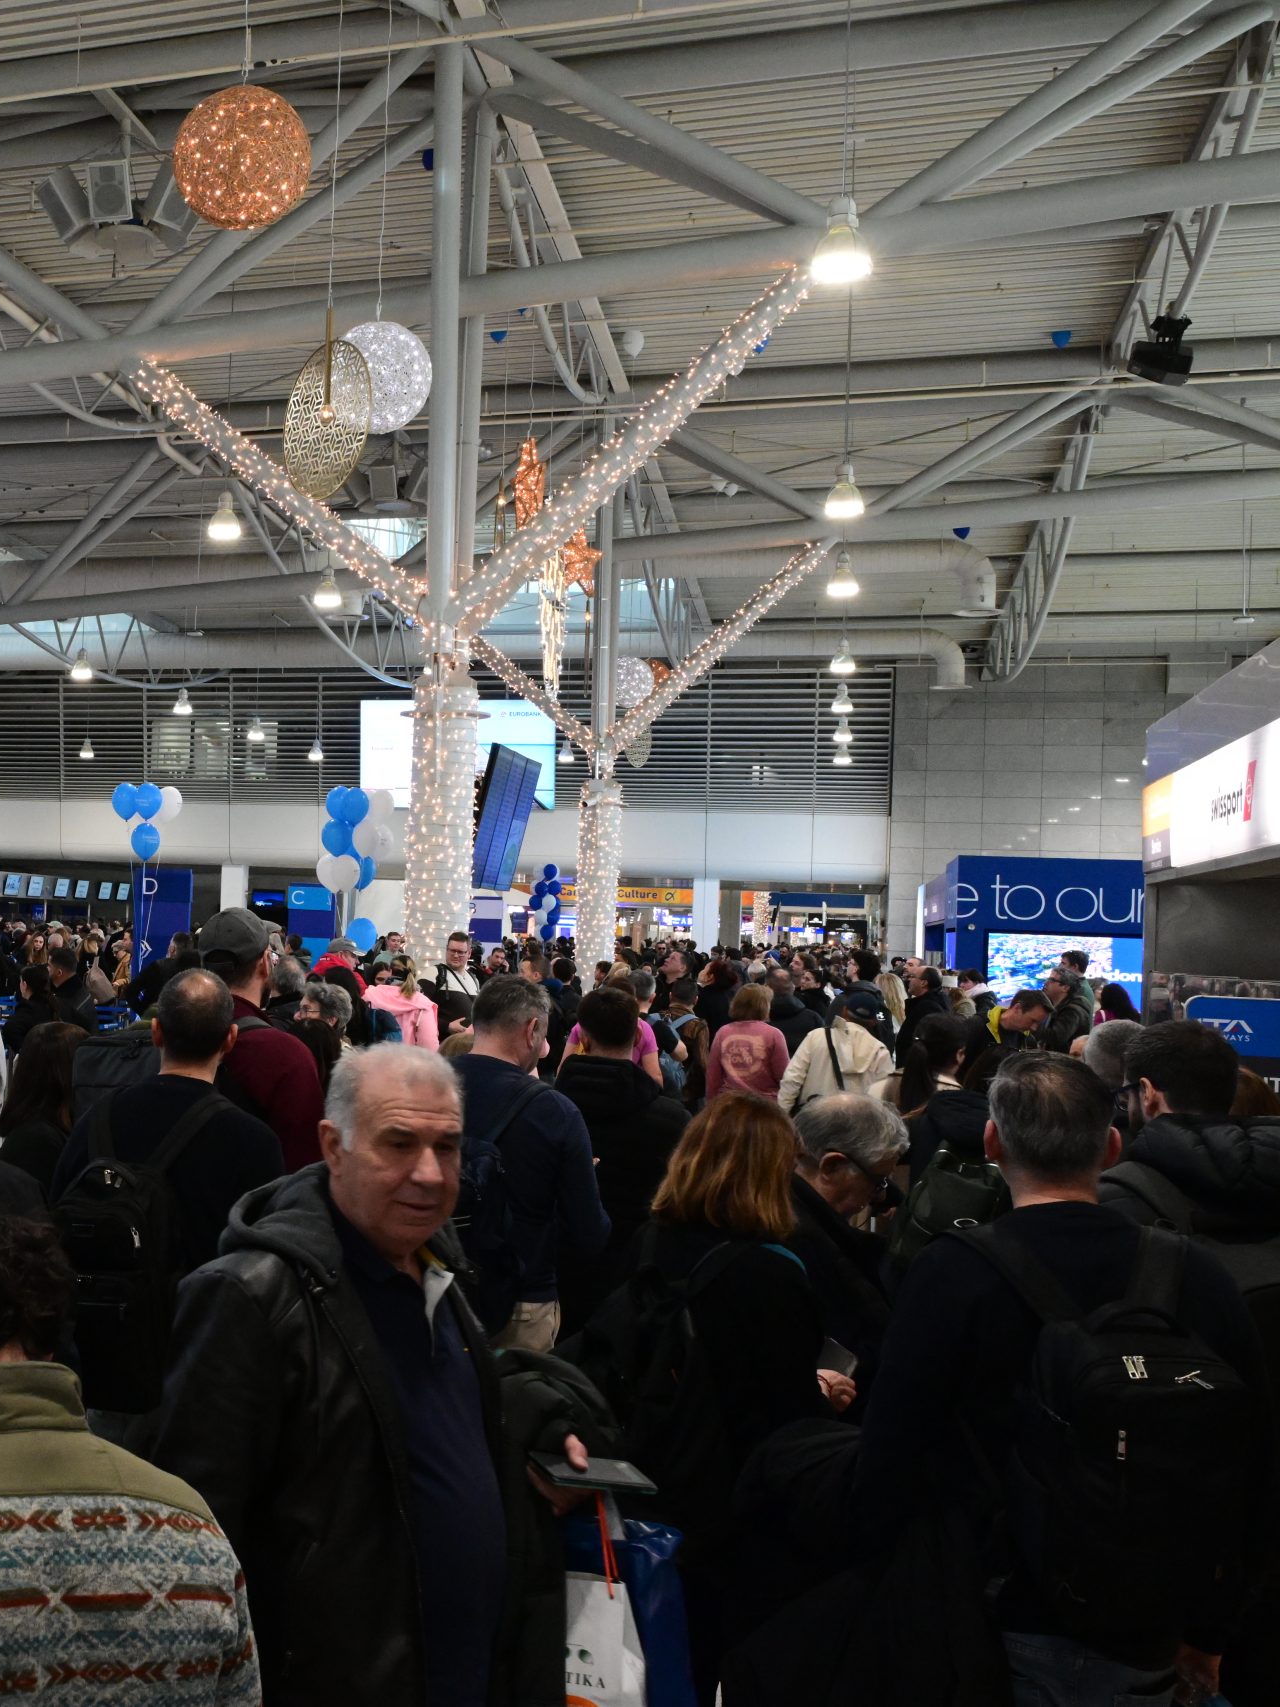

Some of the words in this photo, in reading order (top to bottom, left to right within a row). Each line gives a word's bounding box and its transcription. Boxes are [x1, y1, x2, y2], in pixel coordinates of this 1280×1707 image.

[1211, 782, 1243, 826] swissport
[143, 878, 158, 895] D
[618, 889, 658, 899] Culture
[291, 890, 305, 905] C
[990, 874, 1046, 920] to
